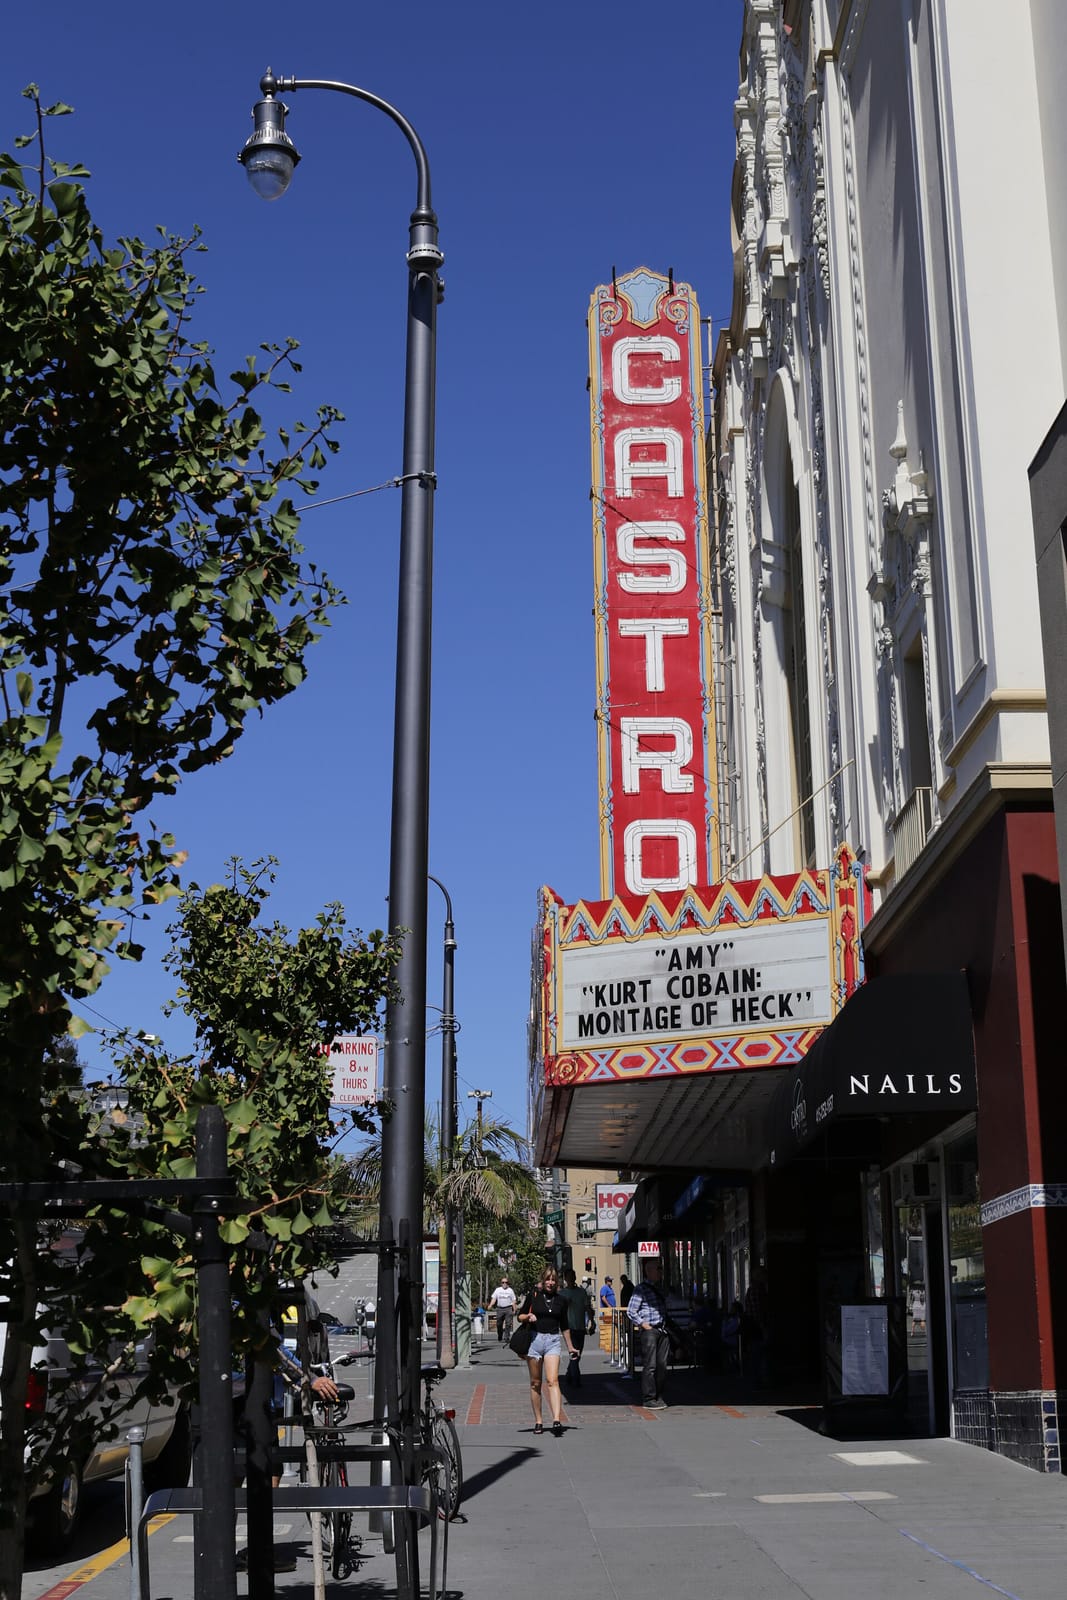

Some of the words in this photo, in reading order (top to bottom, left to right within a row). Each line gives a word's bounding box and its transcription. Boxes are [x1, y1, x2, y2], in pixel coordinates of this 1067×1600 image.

[612, 336, 697, 895] CASTRO
[655, 942, 734, 972] "AMY"
[582, 980, 651, 1008] "KURT
[666, 968, 762, 1000] COBAIN:
[578, 1005, 682, 1038] MONTAGE
[691, 1001, 718, 1027] OF
[732, 991, 812, 1023] HECK"
[333, 1042, 374, 1056] ARKING
[342, 1078, 367, 1089] THURS
[849, 1074, 961, 1094] NAILS
[599, 1193, 634, 1208] HO
[640, 1242, 661, 1252] ATM
